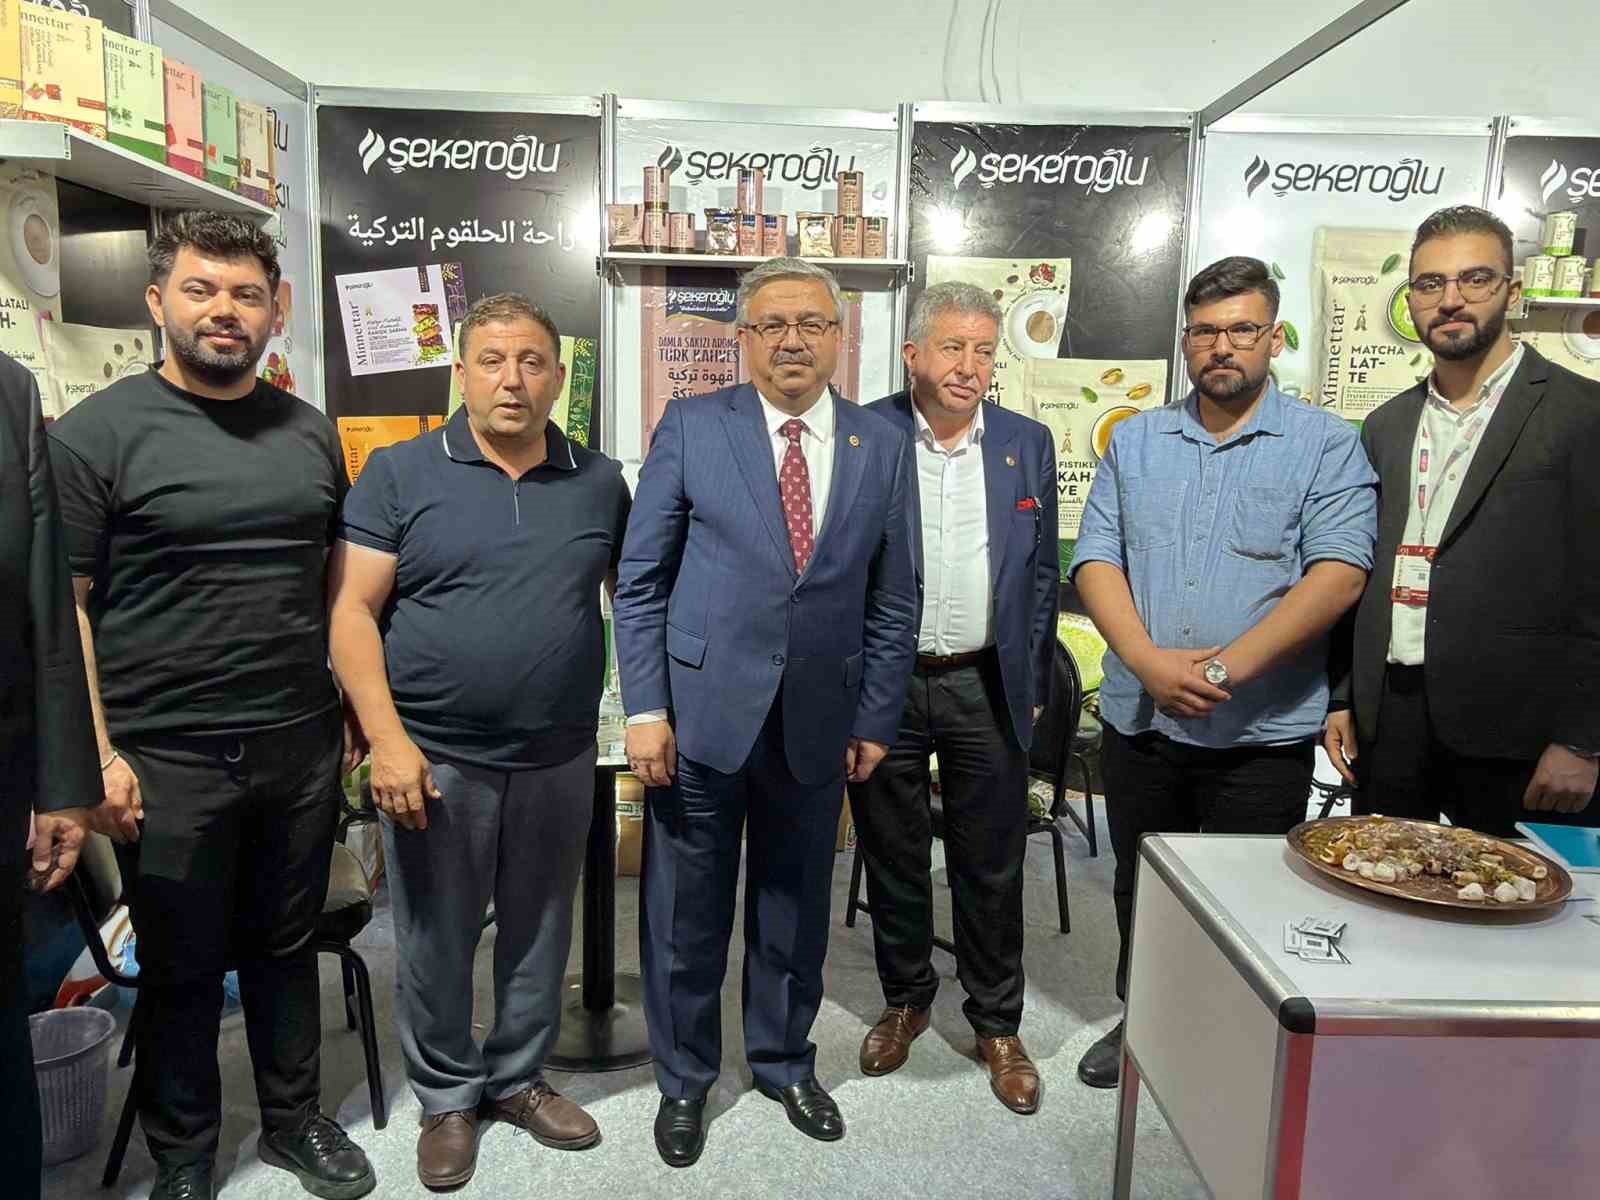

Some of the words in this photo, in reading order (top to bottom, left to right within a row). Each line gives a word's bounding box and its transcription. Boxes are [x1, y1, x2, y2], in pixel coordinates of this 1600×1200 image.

[347, 213, 425, 246] التركية
[430, 219, 515, 251] الحلقوم
[1321, 303, 1346, 409] Minnettar
[1351, 345, 1405, 355] MATCHA
[1350, 357, 1386, 369] LAT-
[702, 369, 733, 385] قهوة
[1348, 371, 1367, 383] TE
